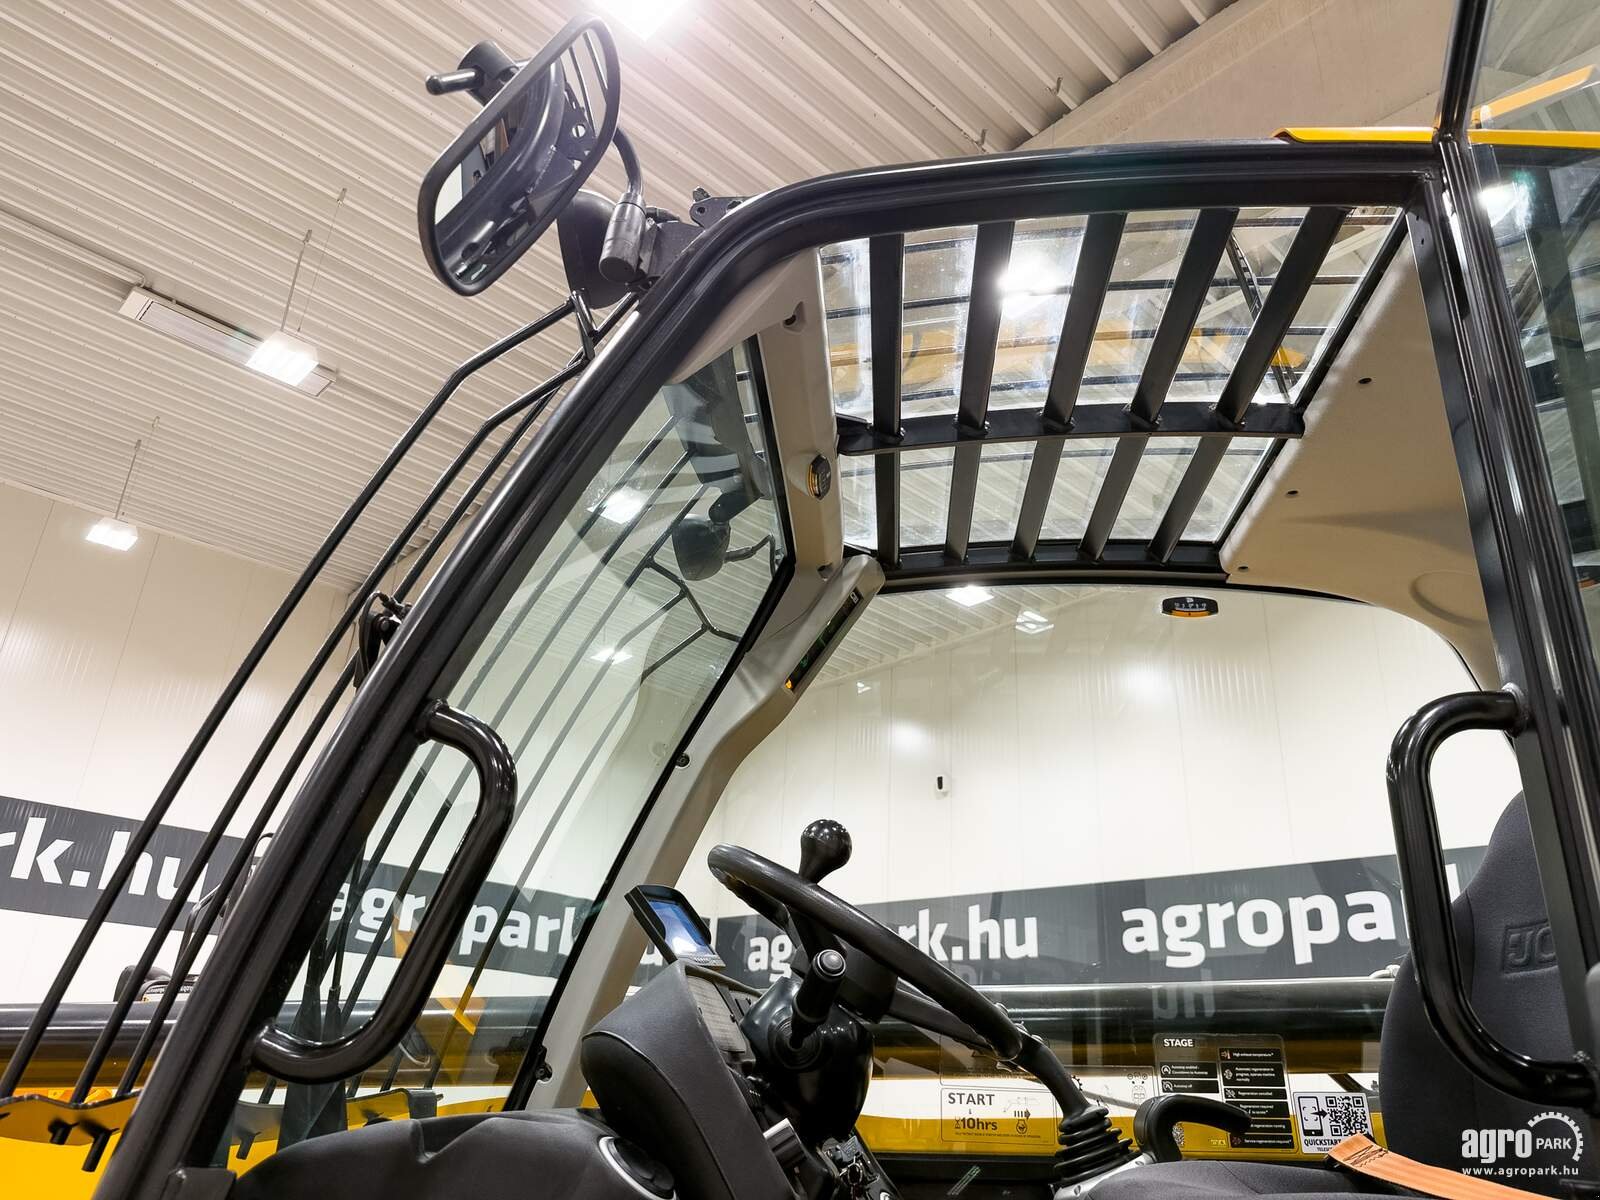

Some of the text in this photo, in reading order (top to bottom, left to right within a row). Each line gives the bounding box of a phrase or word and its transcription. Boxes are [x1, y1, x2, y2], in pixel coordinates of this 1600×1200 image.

[1121, 864, 1461, 968] agropa
[1163, 1039, 1194, 1048] STAGE
[948, 1093, 995, 1106] START
[960, 1117, 998, 1131] 10hrs
